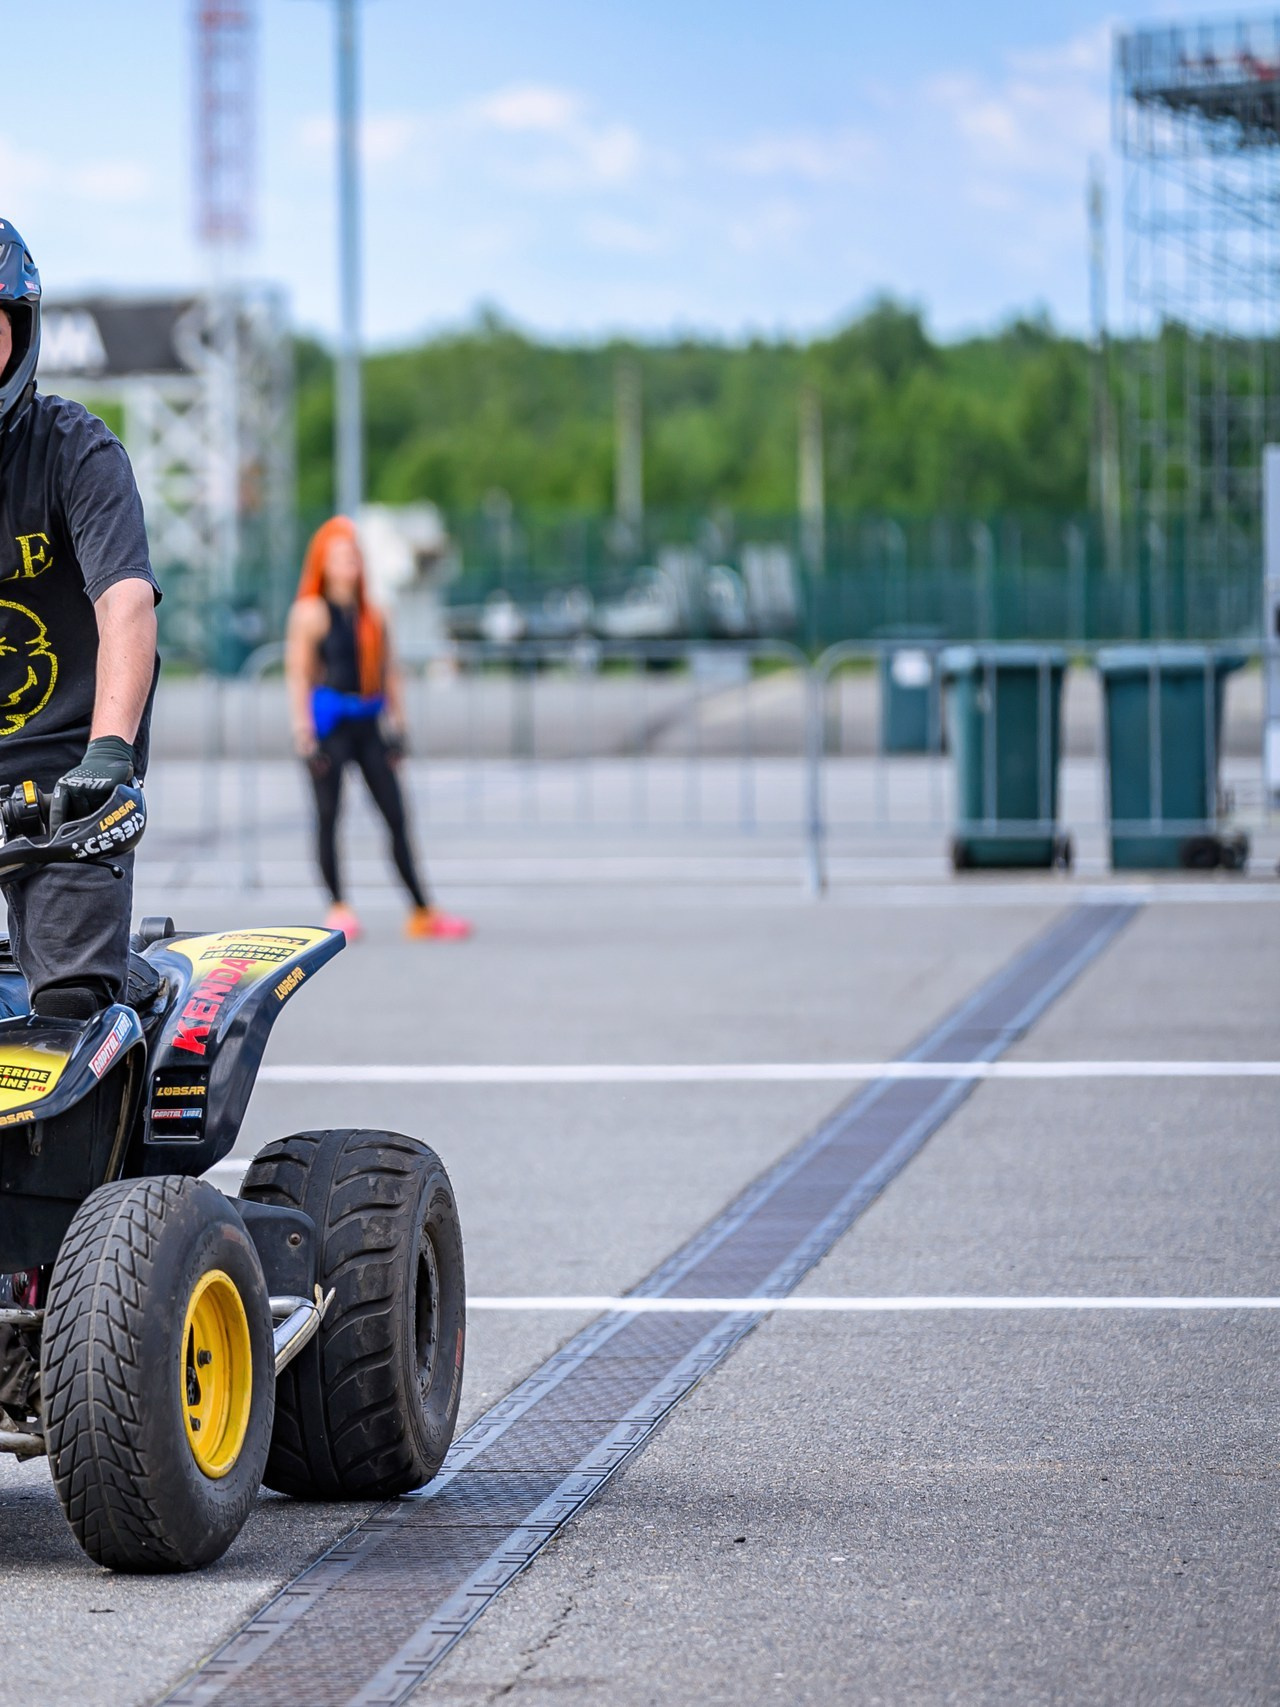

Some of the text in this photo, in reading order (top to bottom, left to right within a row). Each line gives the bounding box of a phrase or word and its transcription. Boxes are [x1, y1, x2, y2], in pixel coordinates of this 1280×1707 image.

[99, 799, 137, 832] LUBSAR
[274, 966, 306, 1002] LUBSAR
[171, 957, 258, 1056] KENDA
[156, 1085, 206, 1096] LUBSAR
